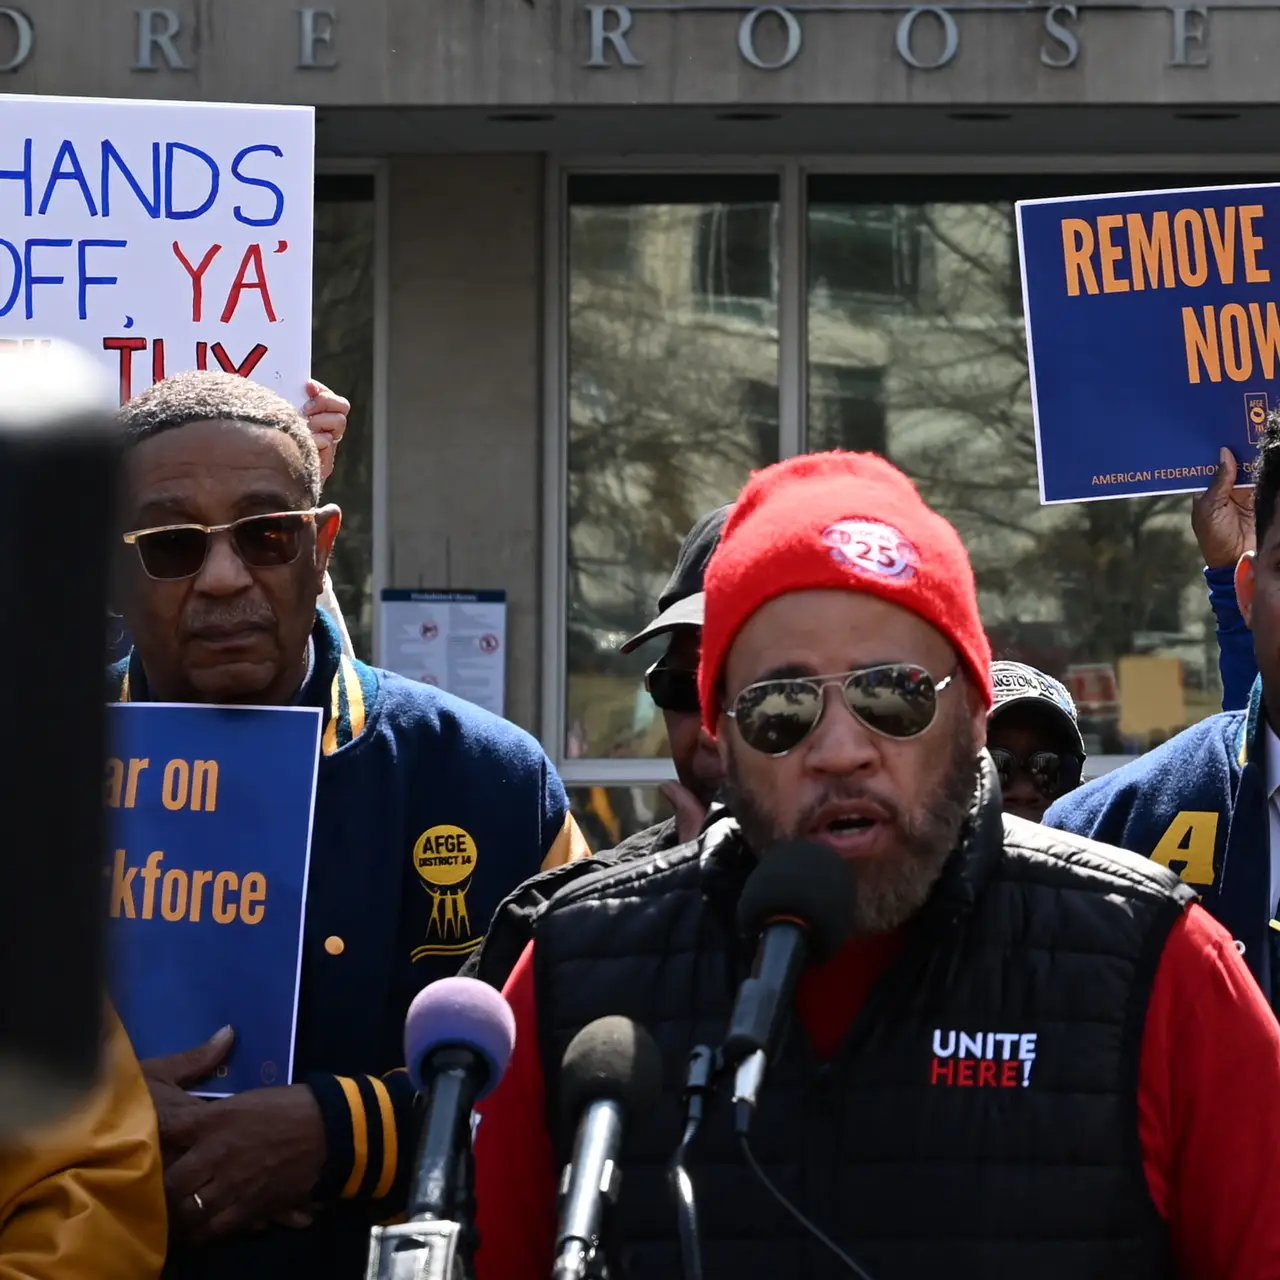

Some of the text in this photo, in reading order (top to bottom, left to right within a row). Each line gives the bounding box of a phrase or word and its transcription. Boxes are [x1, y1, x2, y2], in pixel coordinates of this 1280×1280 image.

[1061, 204, 1270, 296] REMOVE
[1091, 470, 1152, 486] AMERICAN
[855, 541, 898, 569] 25
[105, 757, 219, 812] ar on
[423, 833, 467, 854] AFGE
[419, 855, 472, 867] DISTRICT 14
[109, 849, 267, 925] kforce
[932, 1029, 1037, 1059] UNITE
[931, 1057, 1032, 1087] HERE!
